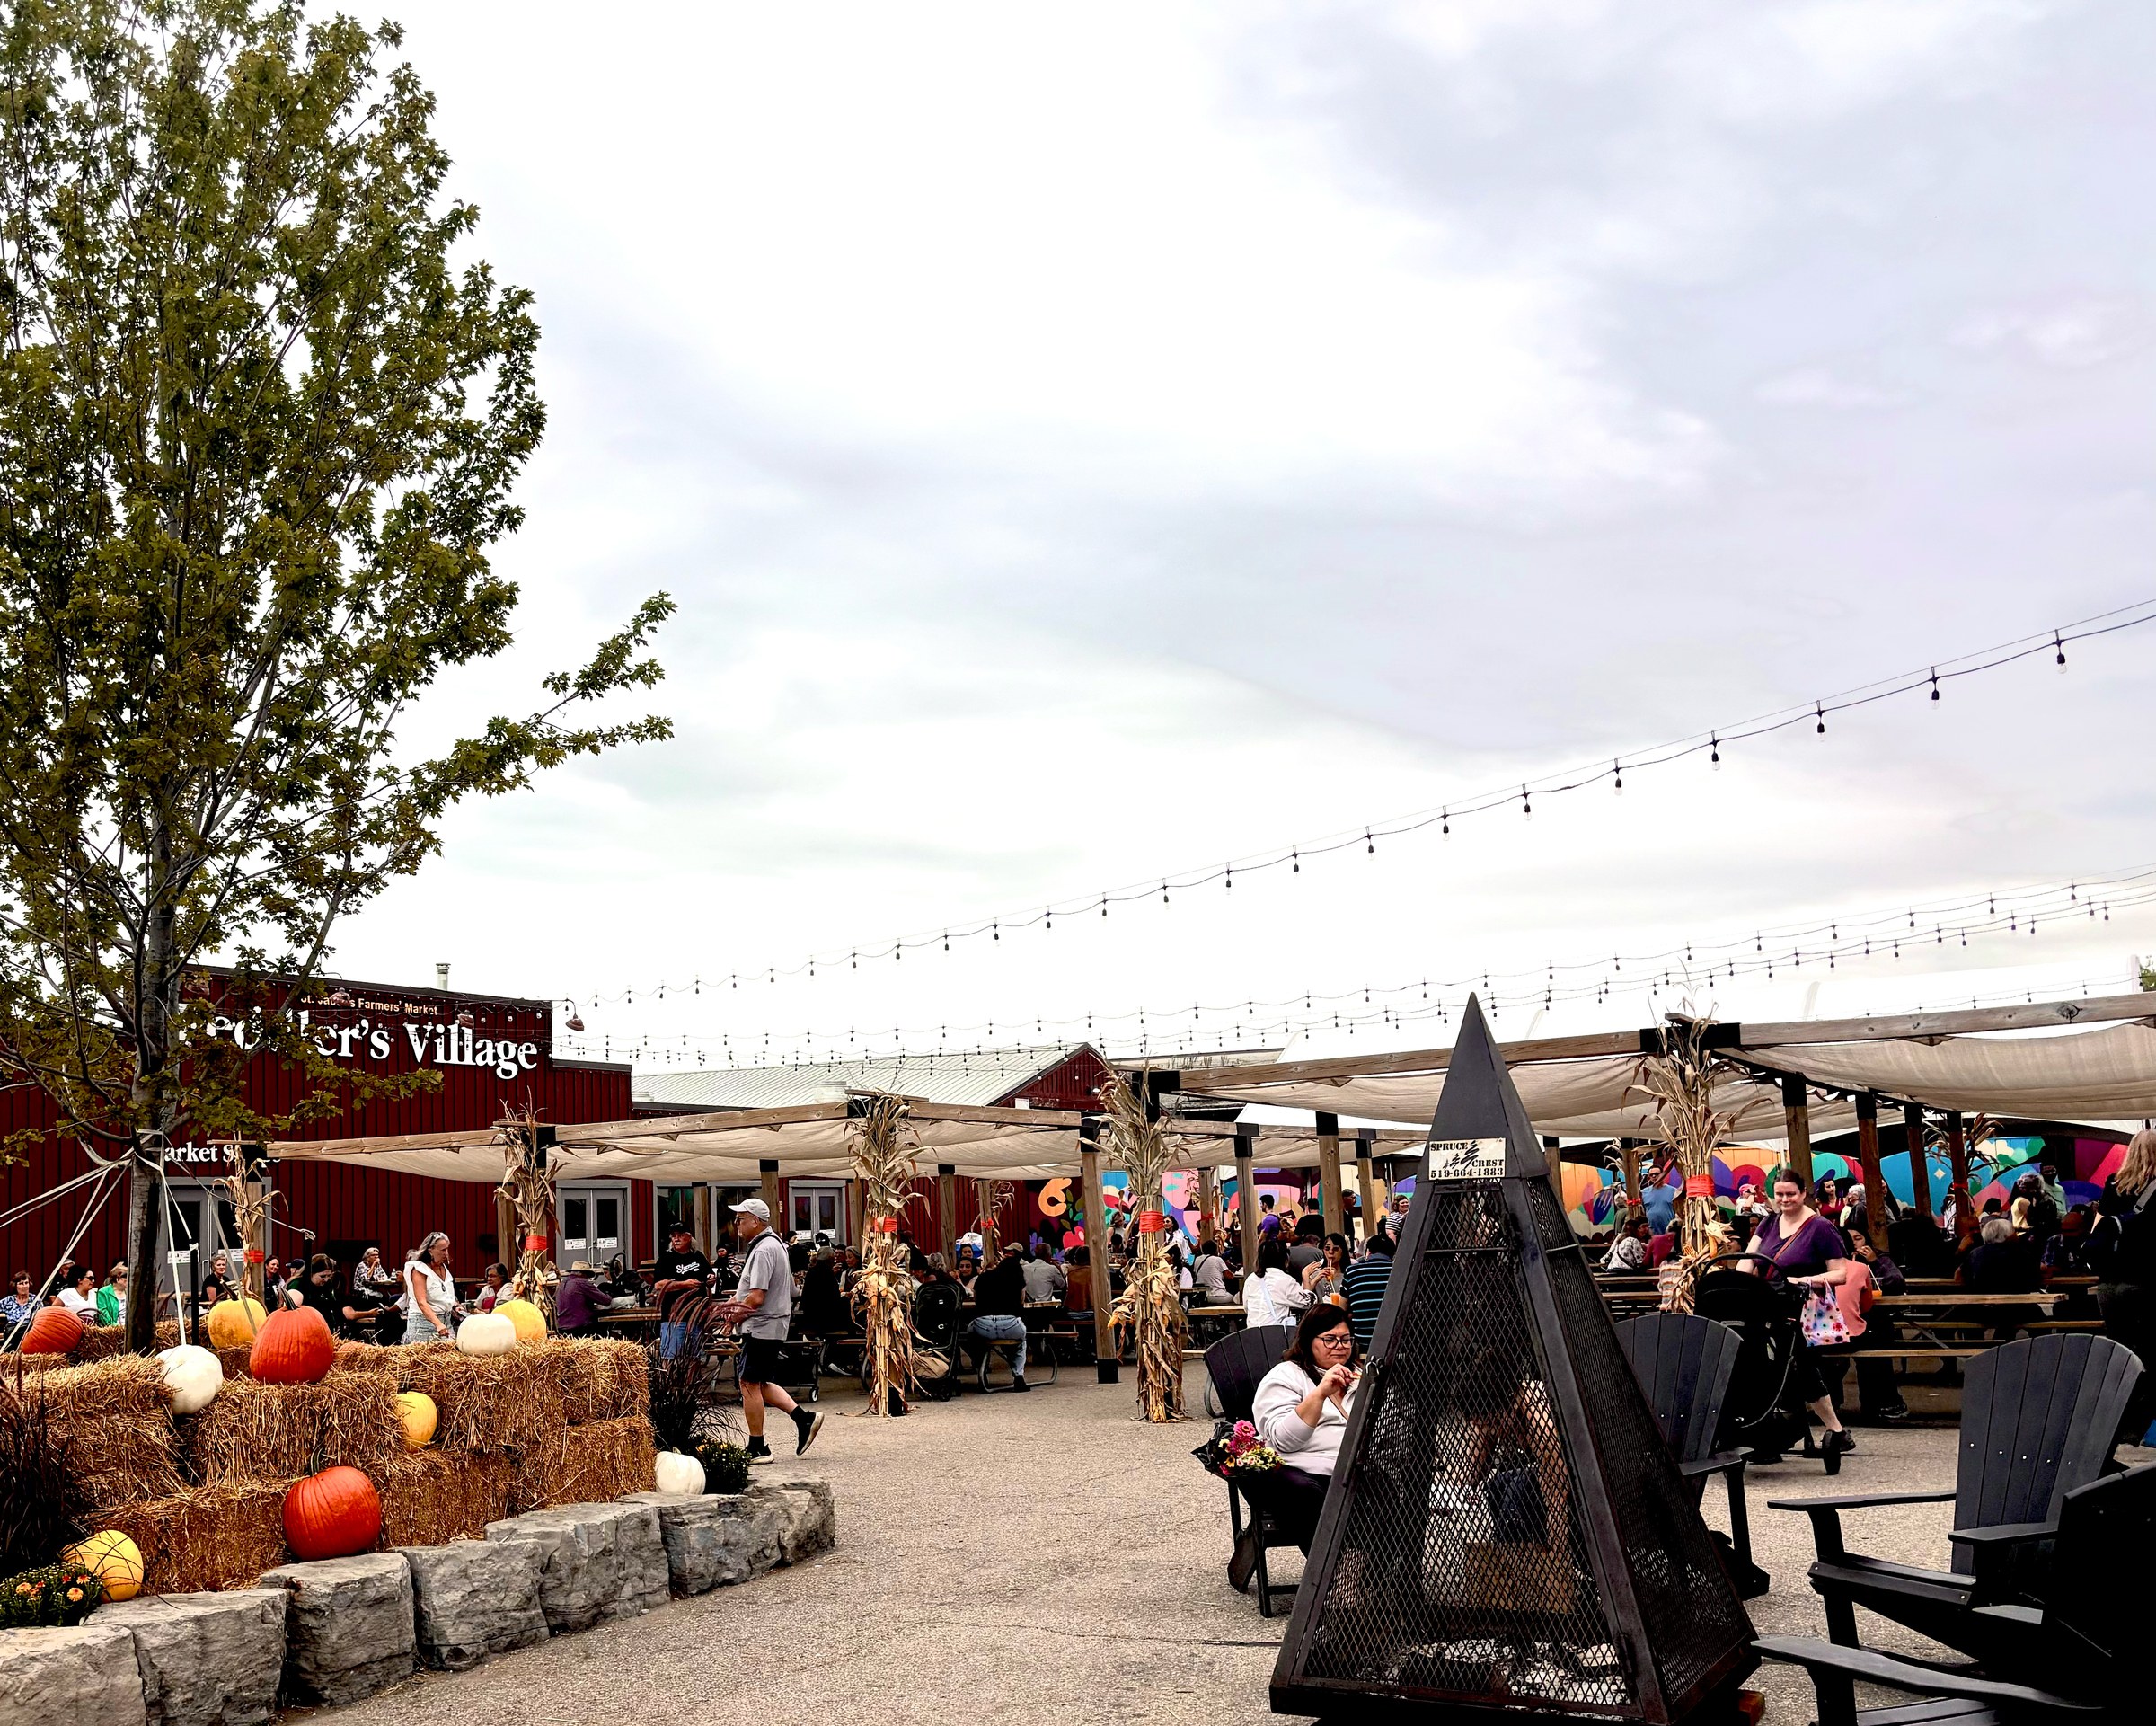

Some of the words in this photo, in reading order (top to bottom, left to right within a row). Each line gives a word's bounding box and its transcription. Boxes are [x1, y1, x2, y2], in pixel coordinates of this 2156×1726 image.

[317, 996, 356, 1008] Jacs
[358, 997, 402, 1012] Farmers'
[404, 1003, 438, 1016] Market
[178, 1003, 392, 1059] edler's
[404, 1023, 538, 1080] Village
[164, 1141, 218, 1162] arket
[1430, 1142, 1468, 1151] SPRUCE
[1471, 1159, 1505, 1167] CREST
[1430, 1168, 1504, 1178] 519-664-1883
